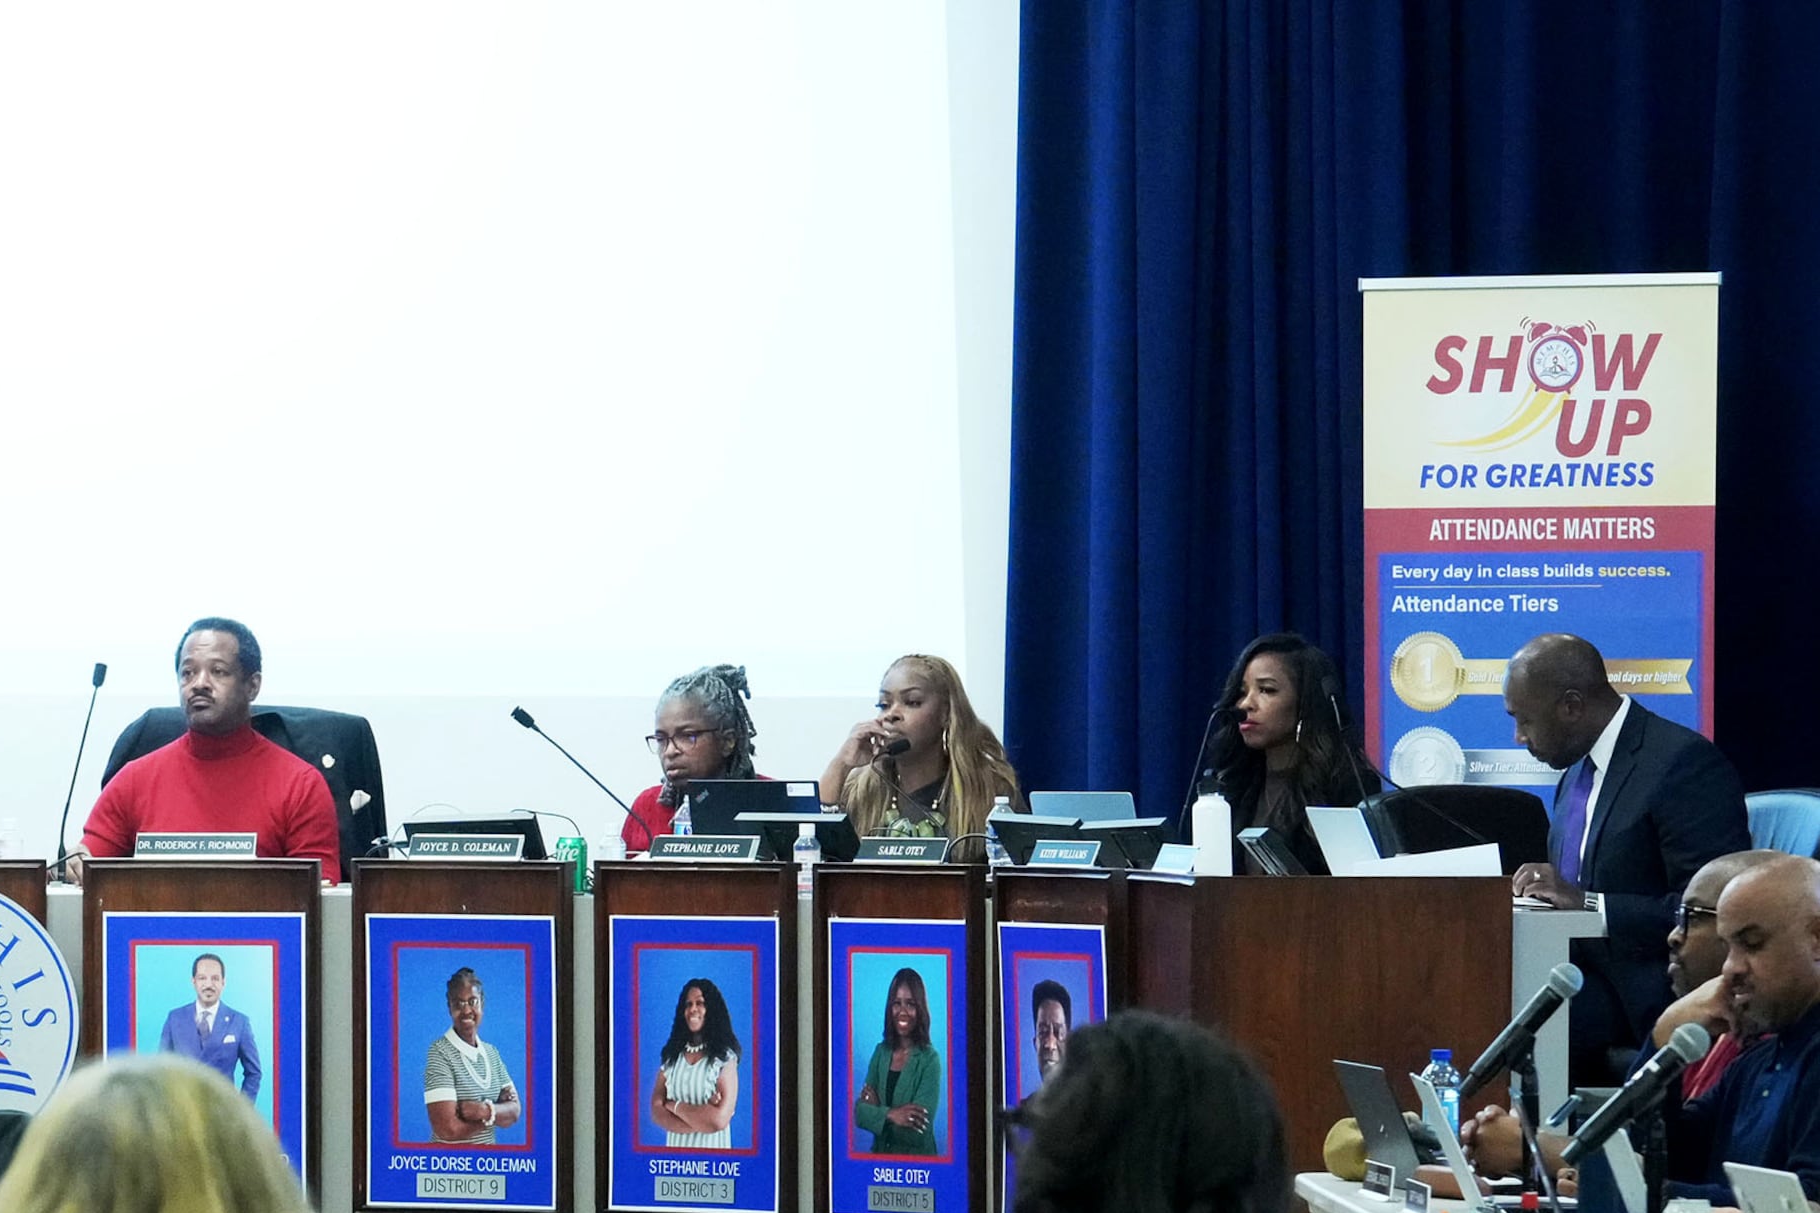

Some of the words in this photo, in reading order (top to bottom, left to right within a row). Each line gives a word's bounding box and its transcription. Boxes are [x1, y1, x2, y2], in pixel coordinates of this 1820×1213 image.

[1555, 399, 1652, 458] UP
[1420, 464, 1478, 488] FOR
[1485, 462, 1654, 487] GREATNESS
[1429, 518, 1557, 541] ATTENDANCE
[1563, 517, 1655, 540] MATTERS
[1392, 565, 1439, 581] Every
[1443, 564, 1473, 581] day
[1478, 564, 1492, 578] in
[1496, 564, 1539, 578] class
[1544, 563, 1594, 578] builds
[1598, 566, 1671, 578] success.
[1391, 594, 1504, 613] Attendance
[1509, 594, 1559, 613] Tiers
[1623, 671, 1643, 685] days
[1643, 674, 1653, 683] or
[1654, 671, 1682, 685] higher
[1469, 761, 1494, 773] Silver
[138, 840, 153, 850] DR.
[155, 840, 199, 850] RODERICK
[208, 840, 252, 851] RICHMOND
[417, 842, 449, 853] JOYCE
[451, 842, 460, 853] D.
[464, 842, 511, 853] COLEMAN
[663, 843, 713, 853] STEPHANIE
[715, 843, 740, 853] LOVE
[878, 846, 904, 856] SABLE
[905, 845, 926, 856] OTEY
[388, 1155, 428, 1171] JOYCE
[431, 1156, 473, 1172] DORSE
[476, 1157, 536, 1173] COLEMAN
[649, 1159, 709, 1176] STEPHANIE
[712, 1161, 740, 1177] LOVE
[873, 1168, 902, 1184] SABLE
[905, 1169, 930, 1185] OTEY
[424, 1177, 485, 1194] DISTRICT
[490, 1179, 499, 1195] 9
[661, 1181, 715, 1199] DISTRICT
[721, 1183, 728, 1199] 3
[873, 1190, 919, 1208] DISTRICT
[921, 1193, 929, 1209] 5
